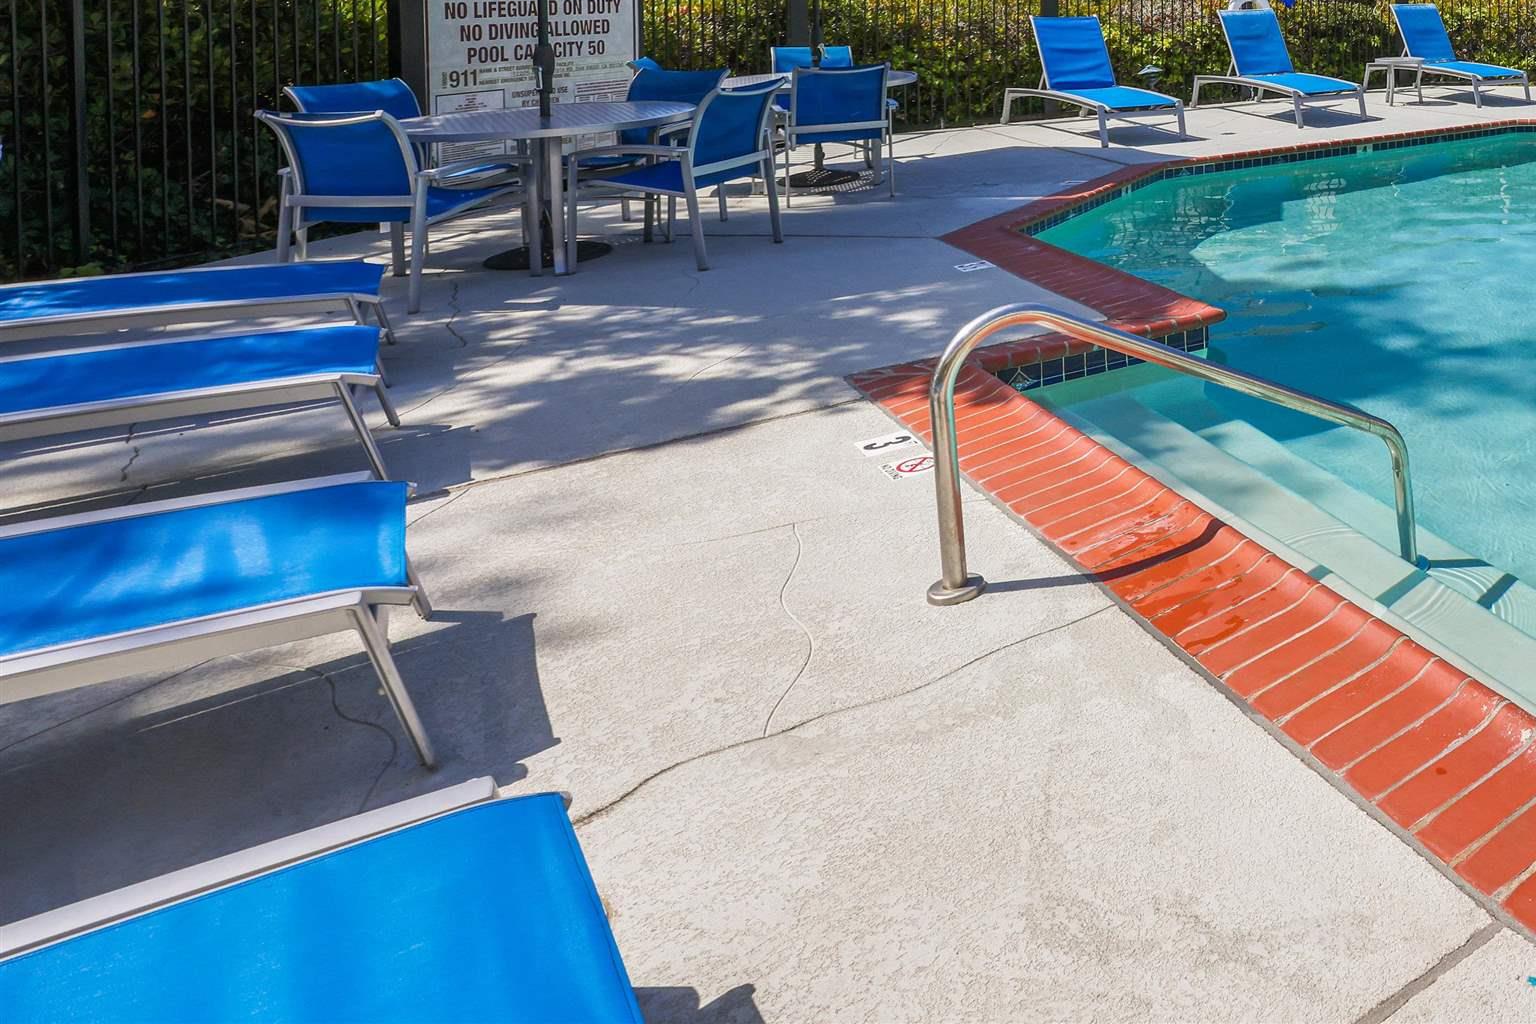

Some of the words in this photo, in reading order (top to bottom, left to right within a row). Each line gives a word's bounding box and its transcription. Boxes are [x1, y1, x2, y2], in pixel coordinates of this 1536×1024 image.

[444, 2, 467, 20] NO
[474, 0, 557, 18] LIFEGUAD
[563, 0, 582, 15] ON
[460, 24, 482, 42] NO
[488, 22, 539, 40] DIVING
[547, 19, 610, 37] ALLOWED
[467, 45, 509, 64] POOL
[514, 41, 583, 61] CACITY
[588, 40, 605, 56] 50
[449, 69, 478, 88] 911
[863, 435, 911, 450] 3
